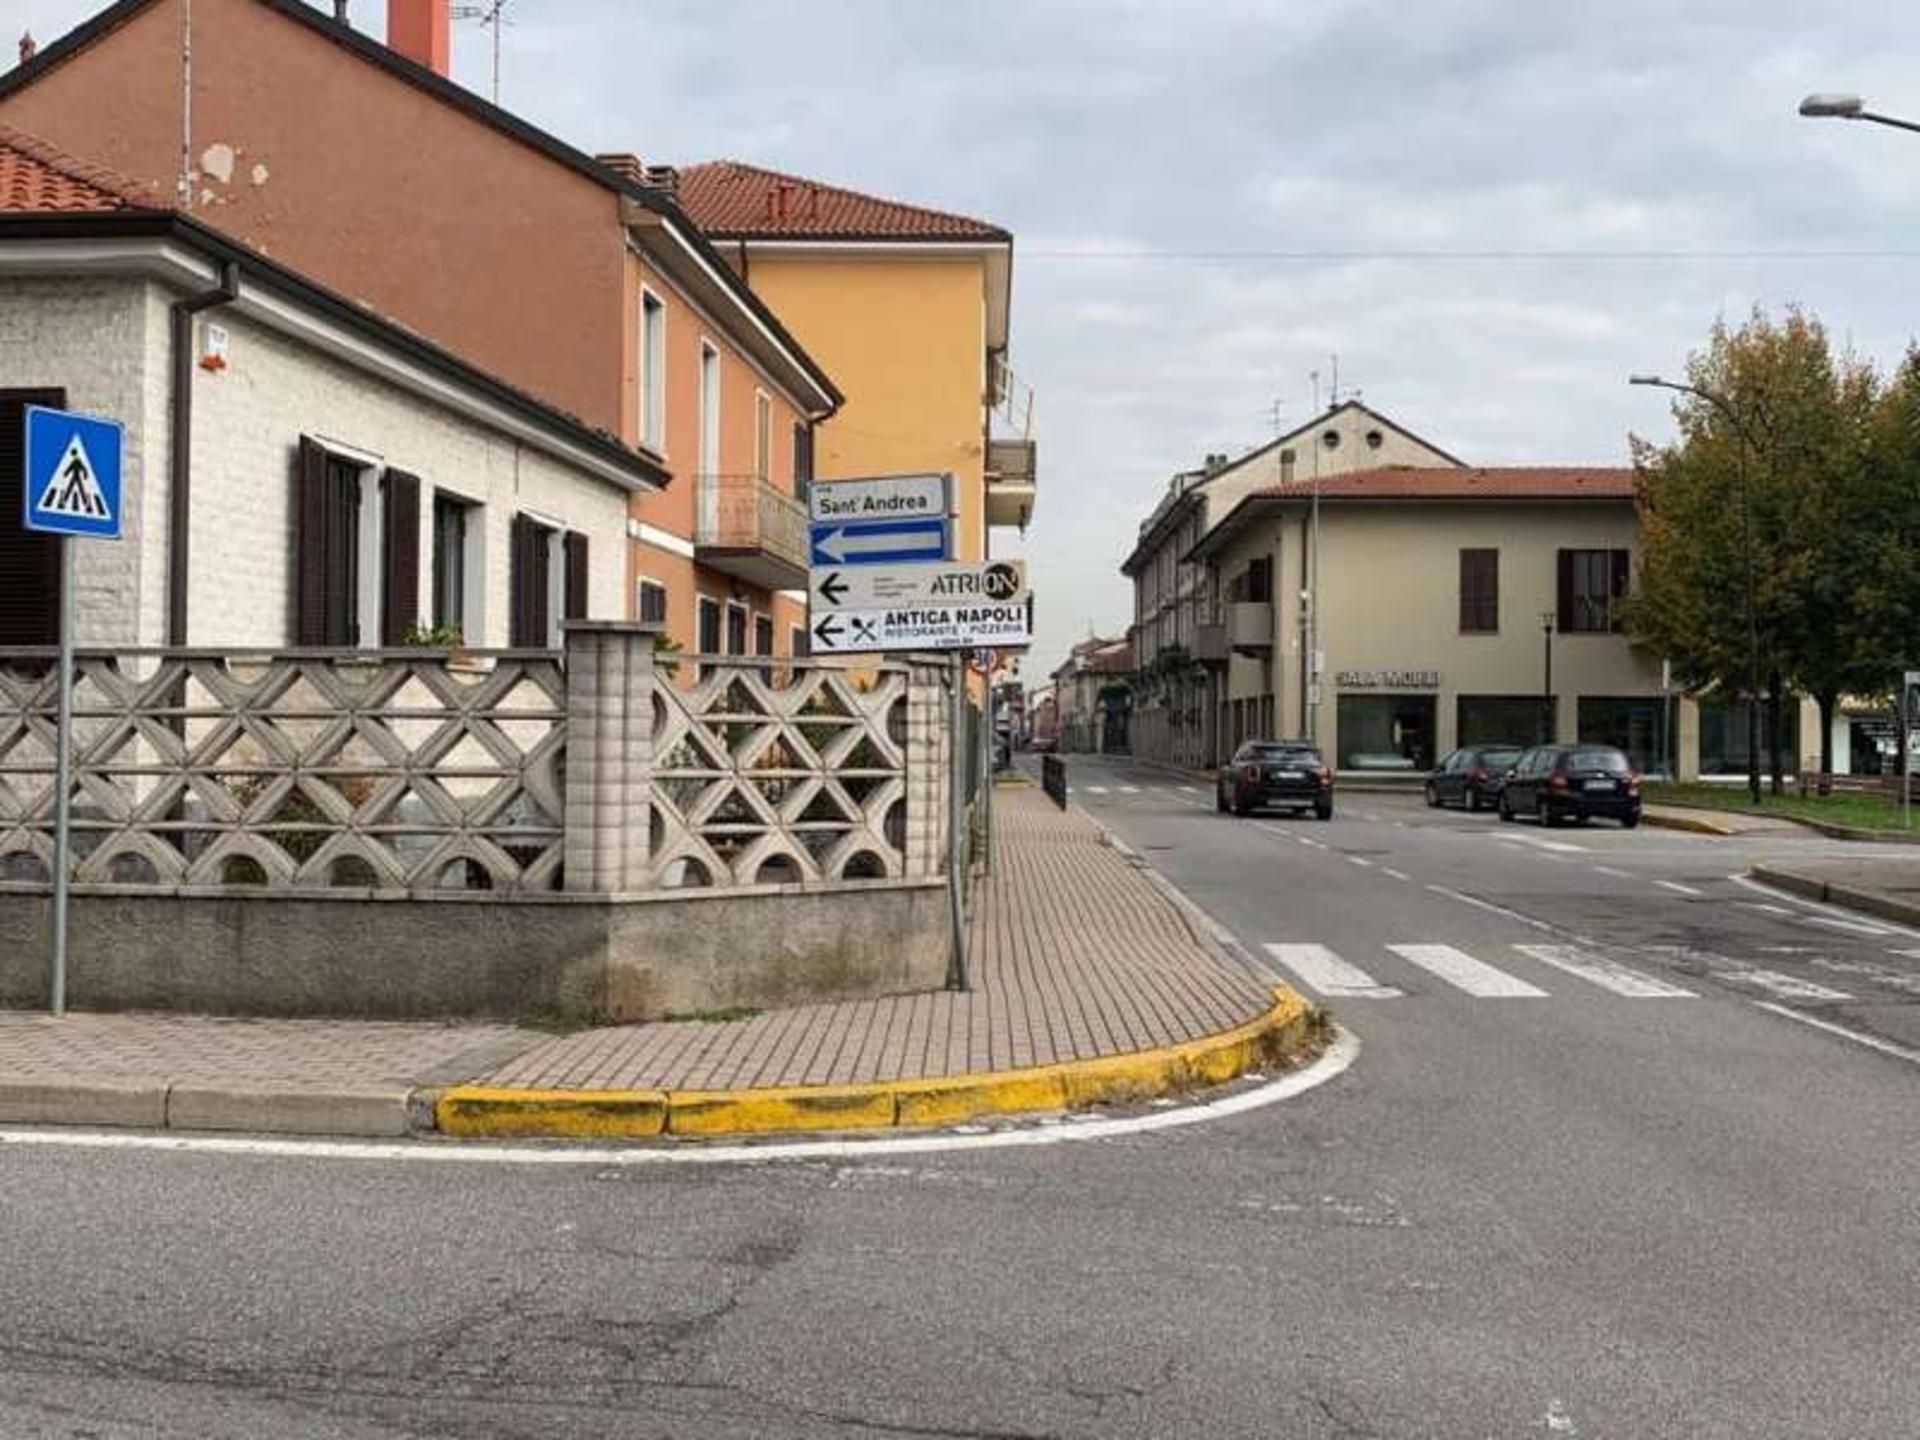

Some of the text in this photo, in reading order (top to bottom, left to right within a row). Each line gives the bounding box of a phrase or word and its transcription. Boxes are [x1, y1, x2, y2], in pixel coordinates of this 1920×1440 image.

[863, 494, 928, 511] Andrea
[930, 567, 1018, 597] ATRION
[884, 607, 1022, 626] ANTICA NAPOLI
[885, 623, 1022, 637] RISTORANTE PIZZERIA
